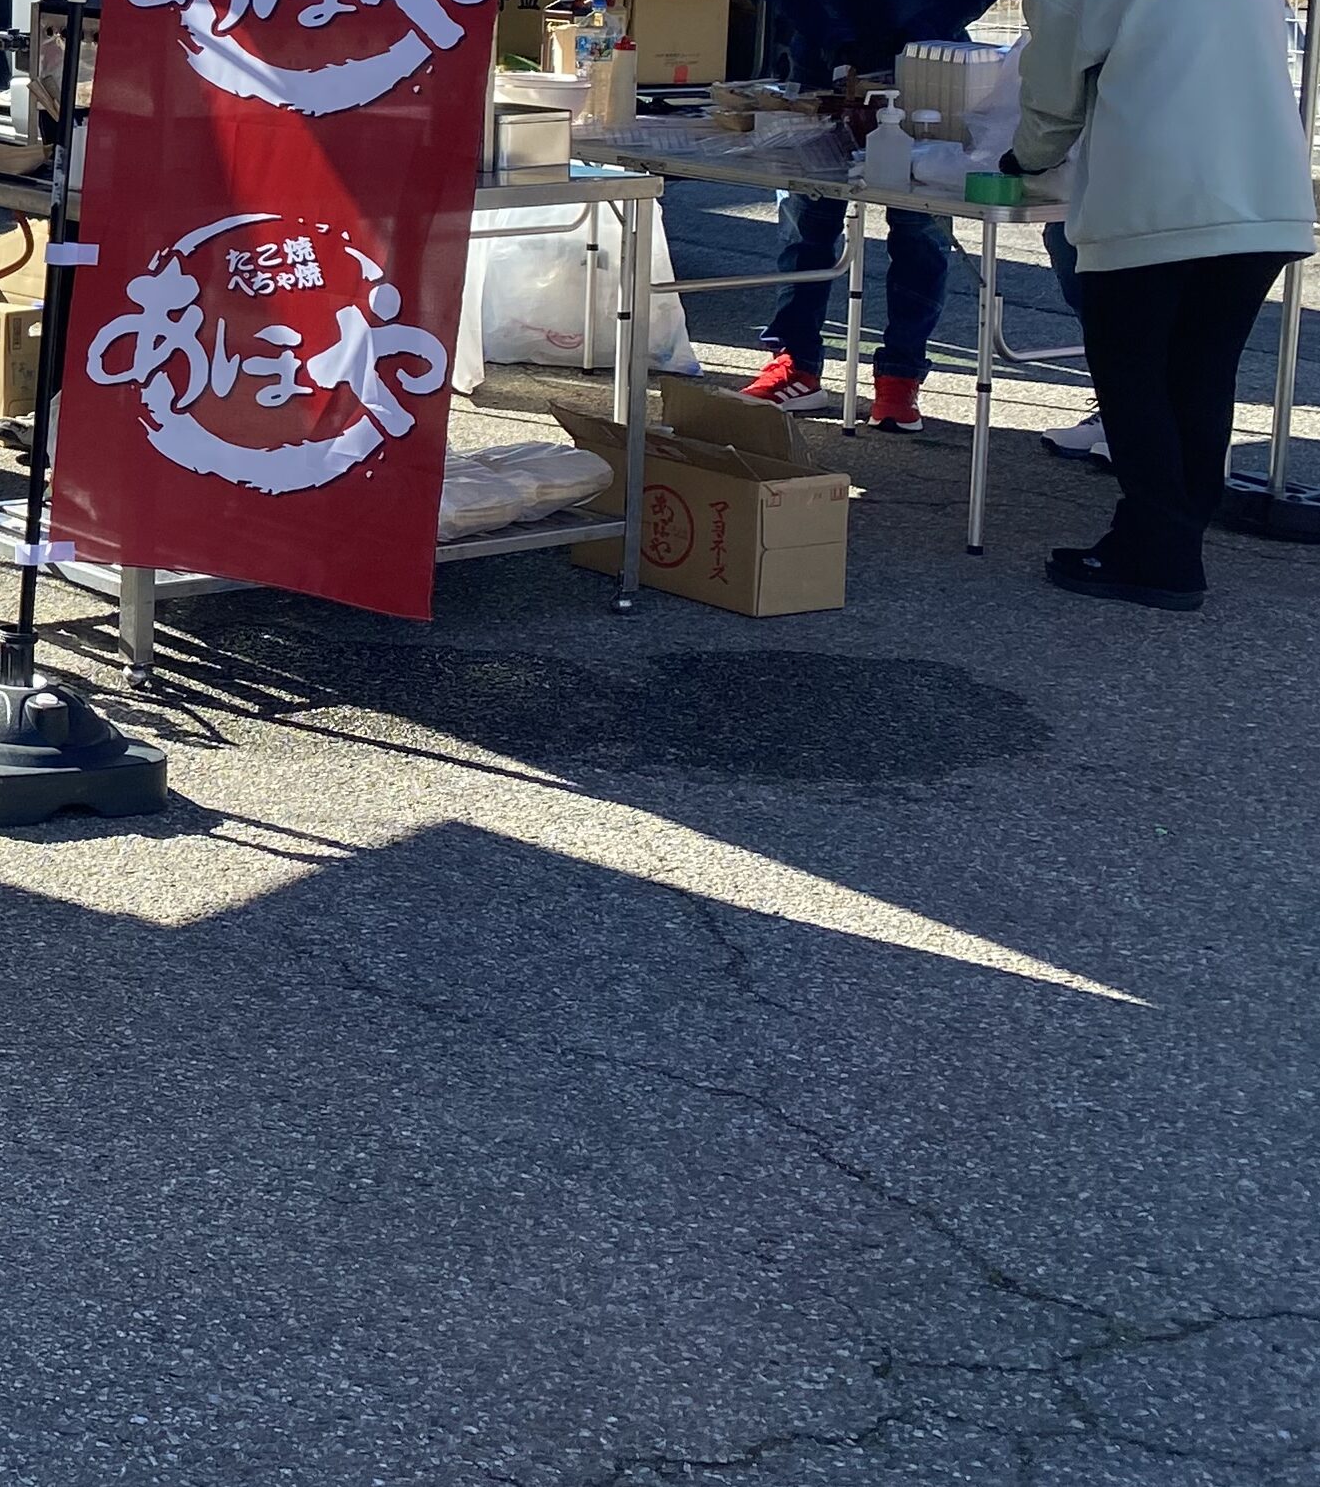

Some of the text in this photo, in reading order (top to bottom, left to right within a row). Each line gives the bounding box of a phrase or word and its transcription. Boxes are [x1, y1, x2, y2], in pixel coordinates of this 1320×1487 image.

[225, 235, 318, 273] たこ焼
[227, 261, 324, 296] ぺちゃ焼
[86, 256, 448, 438] あほや
